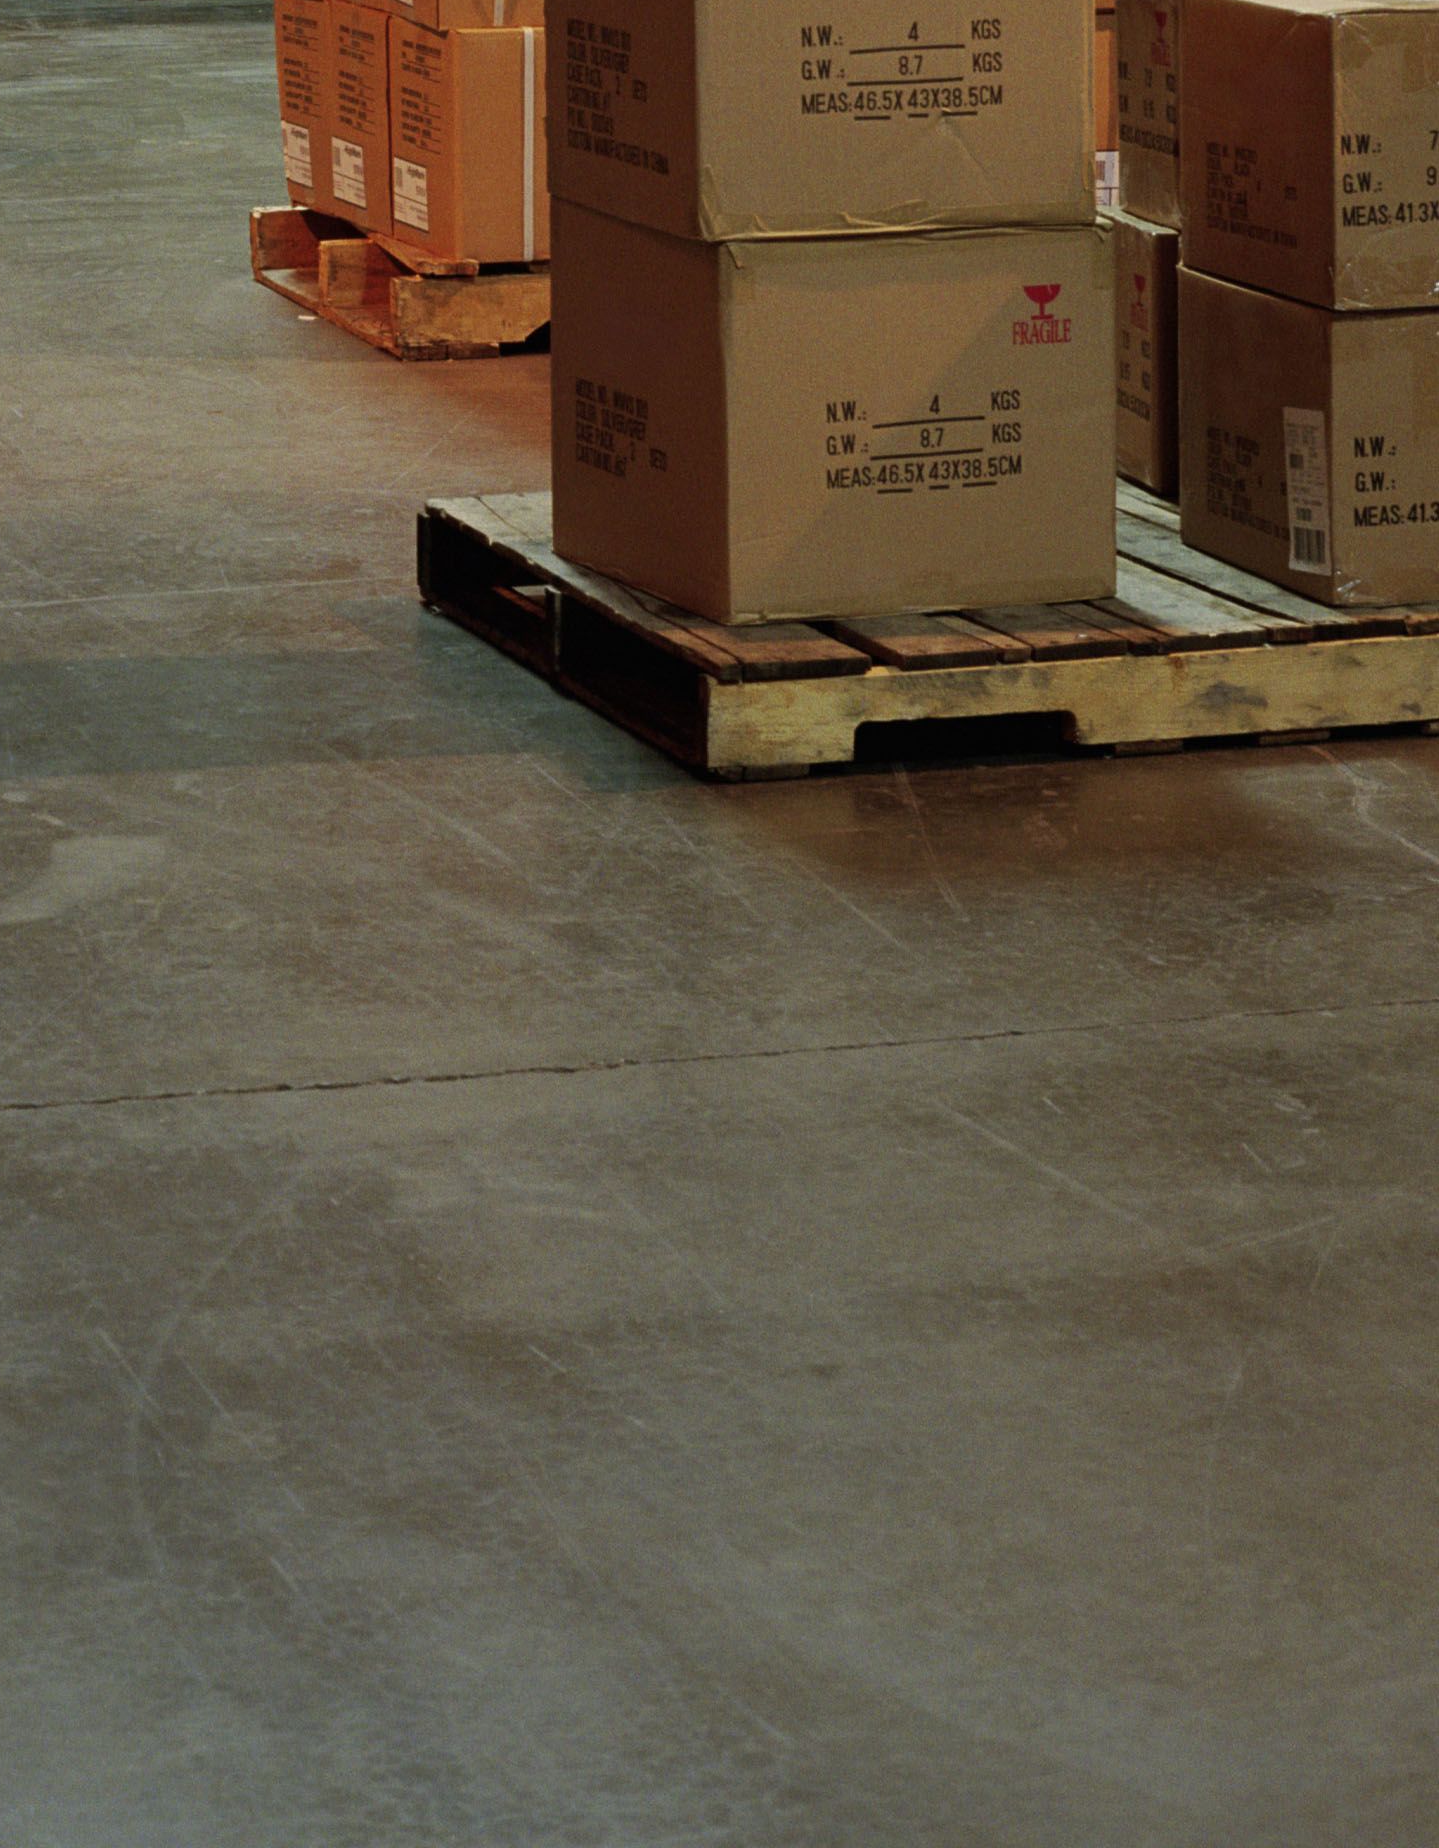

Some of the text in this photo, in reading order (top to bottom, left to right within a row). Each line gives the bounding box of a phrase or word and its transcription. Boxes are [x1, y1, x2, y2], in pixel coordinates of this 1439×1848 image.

[908, 22, 918, 41] 4
[971, 19, 1000, 40] KGS
[899, 56, 922, 75] 8.7
[972, 52, 1002, 72] KGS
[1012, 319, 1072, 344] FRAGILE
[930, 394, 940, 414] 4
[991, 390, 1020, 410] KGS
[920, 428, 944, 448] 8.7
[992, 423, 1022, 443] KGS
